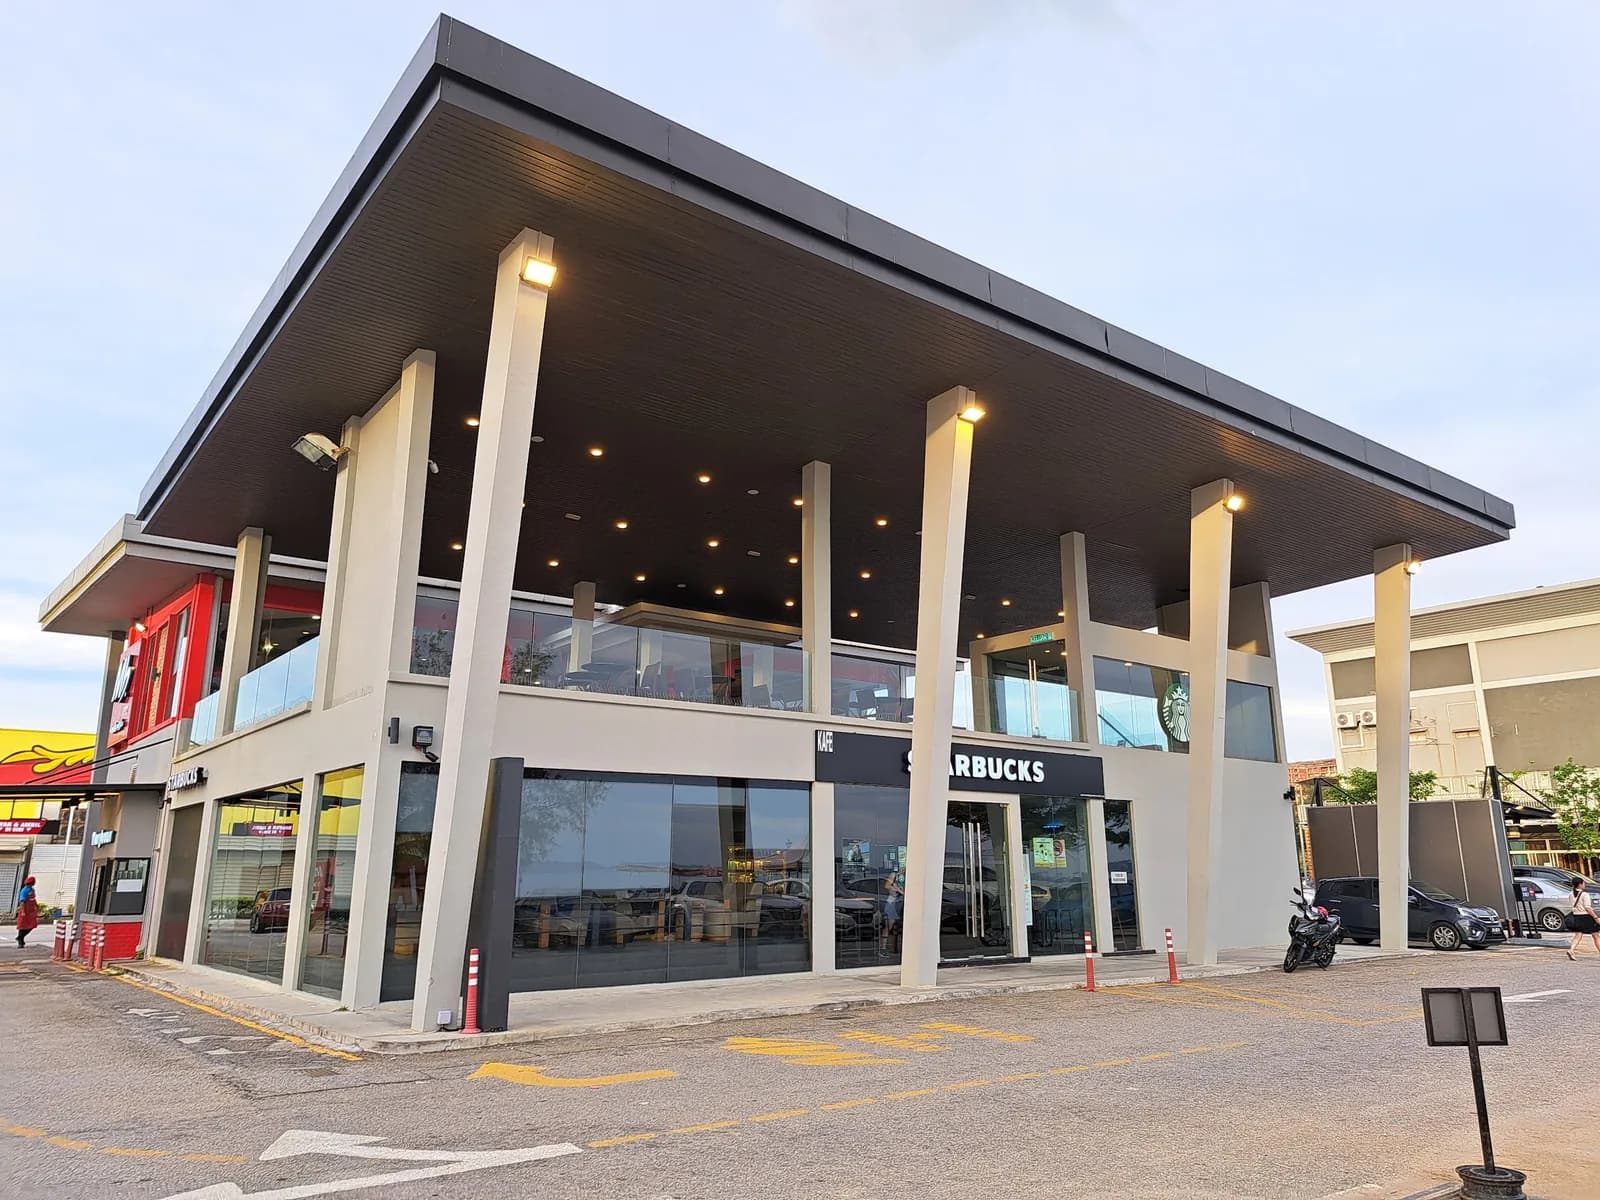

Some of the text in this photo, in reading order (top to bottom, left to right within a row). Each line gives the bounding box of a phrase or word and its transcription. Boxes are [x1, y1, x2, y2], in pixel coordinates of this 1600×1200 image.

[817, 731, 833, 753] KAFE
[907, 749, 1045, 783] RBUCKS
[167, 767, 198, 791] STARBUCKS
